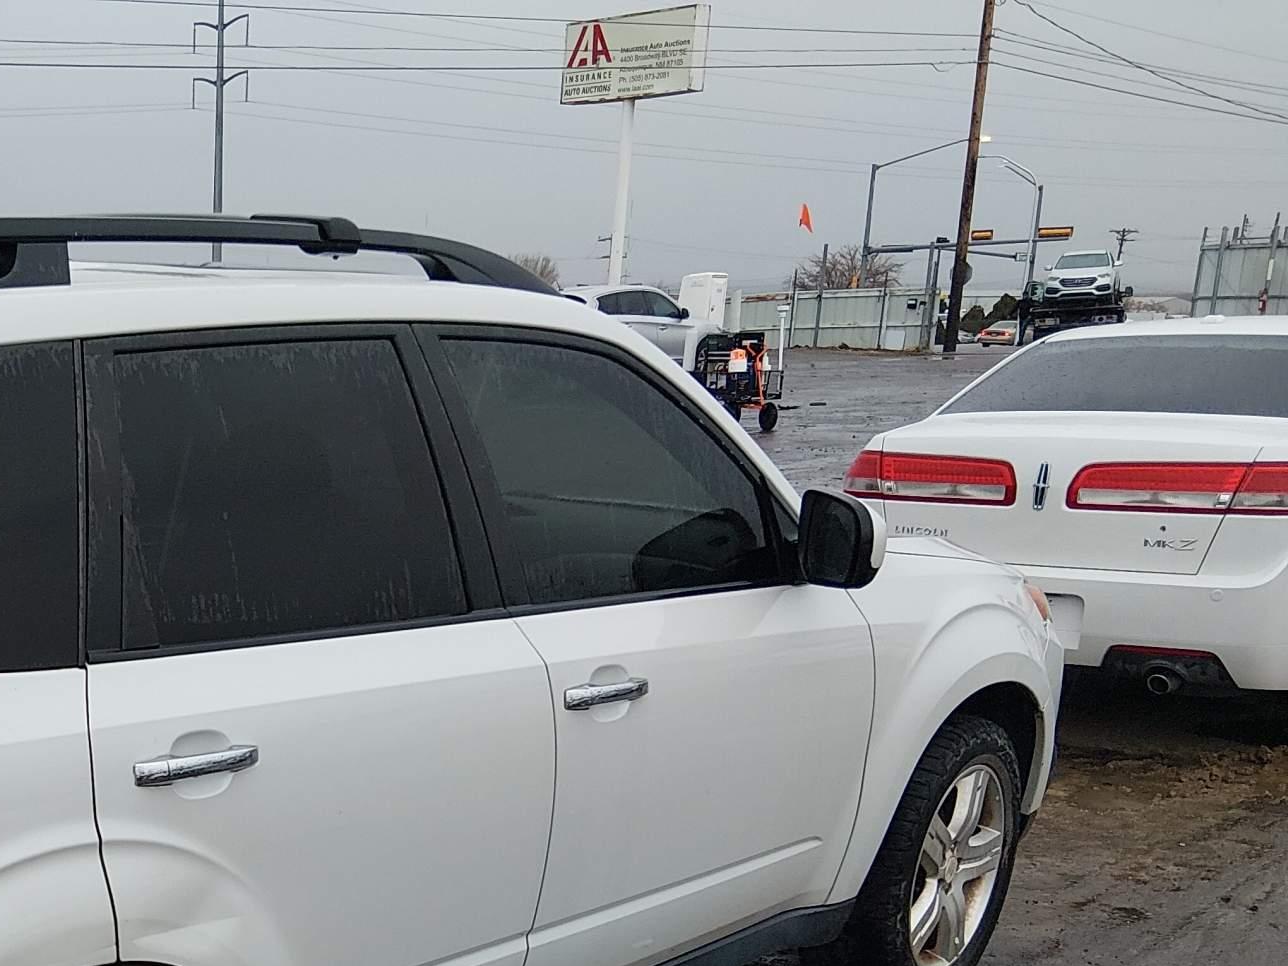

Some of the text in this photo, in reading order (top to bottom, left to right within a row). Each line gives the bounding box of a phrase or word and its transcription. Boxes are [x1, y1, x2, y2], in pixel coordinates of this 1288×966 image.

[664, 39, 691, 48] Auctions
[565, 71, 612, 84] INSURANCE
[564, 84, 611, 97] AUTO AUCTIONS
[894, 525, 949, 538] LINCOLN
